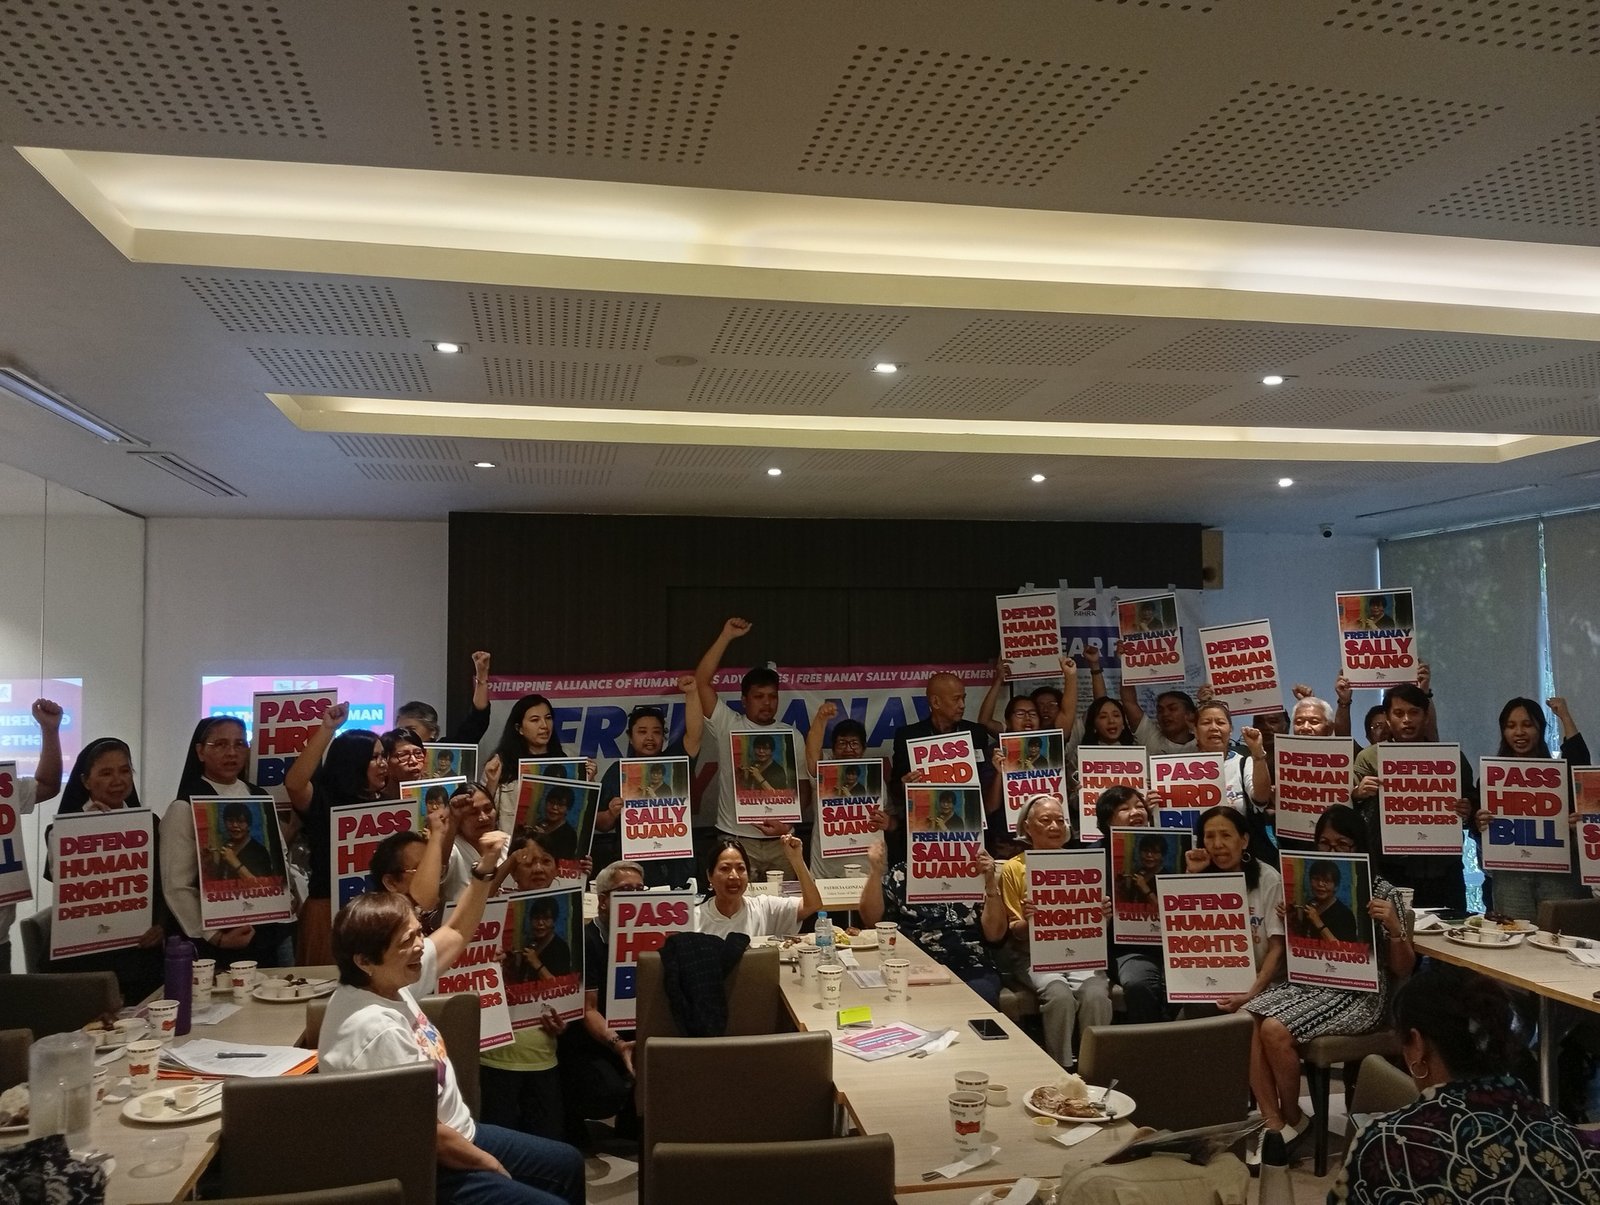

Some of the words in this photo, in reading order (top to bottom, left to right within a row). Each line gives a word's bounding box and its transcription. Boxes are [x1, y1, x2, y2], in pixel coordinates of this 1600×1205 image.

[1001, 605, 1055, 621] DEFEND
[1003, 619, 1057, 634] HUMAN
[1344, 630, 1370, 640] FREE
[1370, 628, 1412, 639] NANAY
[1004, 632, 1058, 649] RIGHTS
[1123, 633, 1143, 642] FREE
[1143, 629, 1176, 640] NANAY
[1005, 647, 1059, 659] DEFENDERS
[1124, 637, 1178, 656] SALLY
[1205, 635, 1269, 655] DEFEND
[1344, 637, 1413, 656] SALLY
[1125, 652, 1180, 668] UJANO
[1208, 650, 1272, 670] HUMAN
[1346, 654, 1414, 670] UJANO
[488, 680, 553, 692] PHILIPPINE
[554, 679, 612, 691] ALLIANCE
[615, 679, 632, 690] OF
[634, 677, 679, 688] HUMAN
[796, 673, 822, 684] FREE
[824, 672, 864, 683] NANAY
[866, 672, 898, 682] SALLY
[1211, 666, 1275, 686] RIGHTS
[1213, 680, 1277, 696] DEFENDERS
[259, 698, 332, 724] PASS
[348, 709, 383, 721] MAN
[913, 740, 970, 764] PASS
[1279, 751, 1350, 768] DEFEND
[916, 762, 973, 783] HRD
[1007, 771, 1028, 781] FREE
[1028, 768, 1061, 778] NANAY
[1082, 761, 1143, 774] DEFEND
[1156, 761, 1220, 781] PASS
[1382, 760, 1456, 775] DEFEND
[1083, 777, 1144, 789] HUMAN
[1279, 768, 1349, 785] HUMAN
[1487, 766, 1561, 788] PASS
[1007, 777, 1063, 796] SALLY
[1280, 784, 1350, 803] RIGHTS
[1383, 778, 1456, 793] HUMAN
[625, 800, 649, 808] FREE
[648, 798, 687, 807] NANAY
[739, 797, 763, 806] SALLY
[764, 796, 795, 805] UJANO!
[822, 799, 845, 807] FREE
[844, 796, 880, 806] NANAY
[1157, 784, 1222, 808] HRD
[1384, 796, 1457, 812] RIGHTS
[1487, 790, 1562, 817] HRD
[625, 807, 687, 825] SALLY
[822, 804, 881, 823] SALLY
[1280, 801, 1331, 815] DEFEND
[338, 809, 412, 841] PASS
[1385, 814, 1458, 825] DEFENDERS
[626, 823, 688, 840] UJANO
[823, 820, 880, 837] UJANO
[912, 832, 939, 842] FREE
[939, 831, 980, 842] NANAY
[1488, 818, 1565, 848] BILL
[59, 829, 149, 857] DEFEND
[912, 842, 981, 862] SALLY
[59, 851, 149, 879] HUMAN
[912, 862, 979, 879] UJANO
[1031, 868, 1102, 886] DEFEND
[59, 874, 149, 904] RIGHTS
[207, 890, 241, 903] SALLY
[1032, 888, 1101, 905] HUMAN
[58, 897, 148, 921] DEFENDERS
[1163, 893, 1244, 912] DEFEND
[618, 901, 689, 927] PASS
[1033, 907, 1103, 927] RIGHTS
[1165, 913, 1246, 931] HUMAN
[1034, 927, 1103, 942] DEFENDERS
[1167, 934, 1248, 954] RIGHTS
[1292, 946, 1323, 960] SALLY
[1169, 956, 1250, 969] DEFENDERS
[438, 968, 499, 994] RIGHTS
